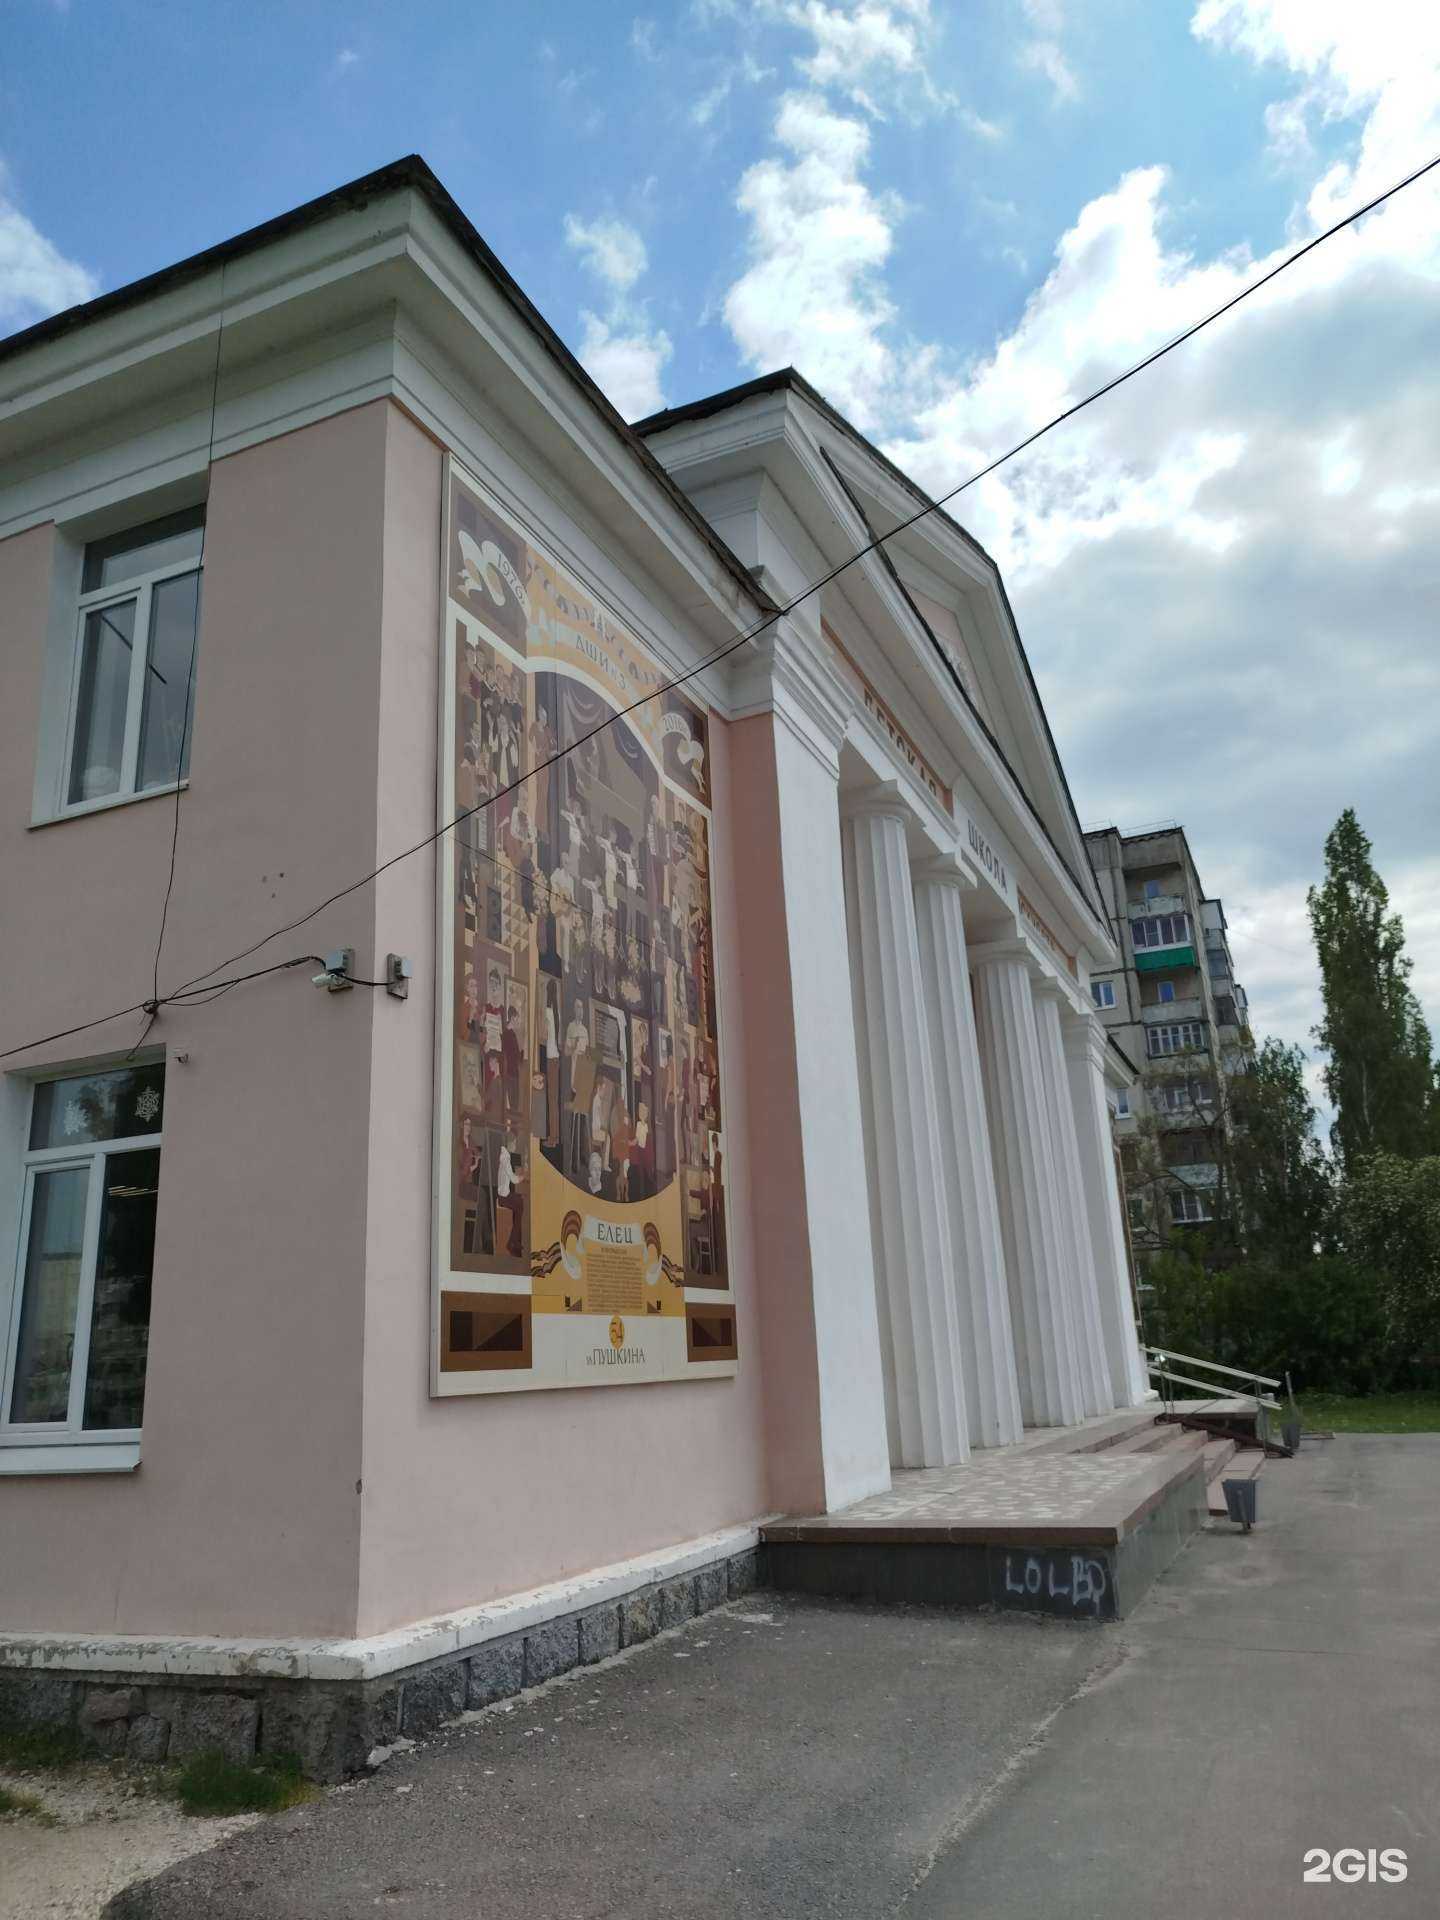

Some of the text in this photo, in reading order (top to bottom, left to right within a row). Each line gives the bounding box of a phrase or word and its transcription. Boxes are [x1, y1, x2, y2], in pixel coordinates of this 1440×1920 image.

[967, 819, 1009, 894] ШКОЛА
[597, 1223, 633, 1245] ЕЛЕЦ
[593, 1347, 647, 1366] ПУШКИНА
